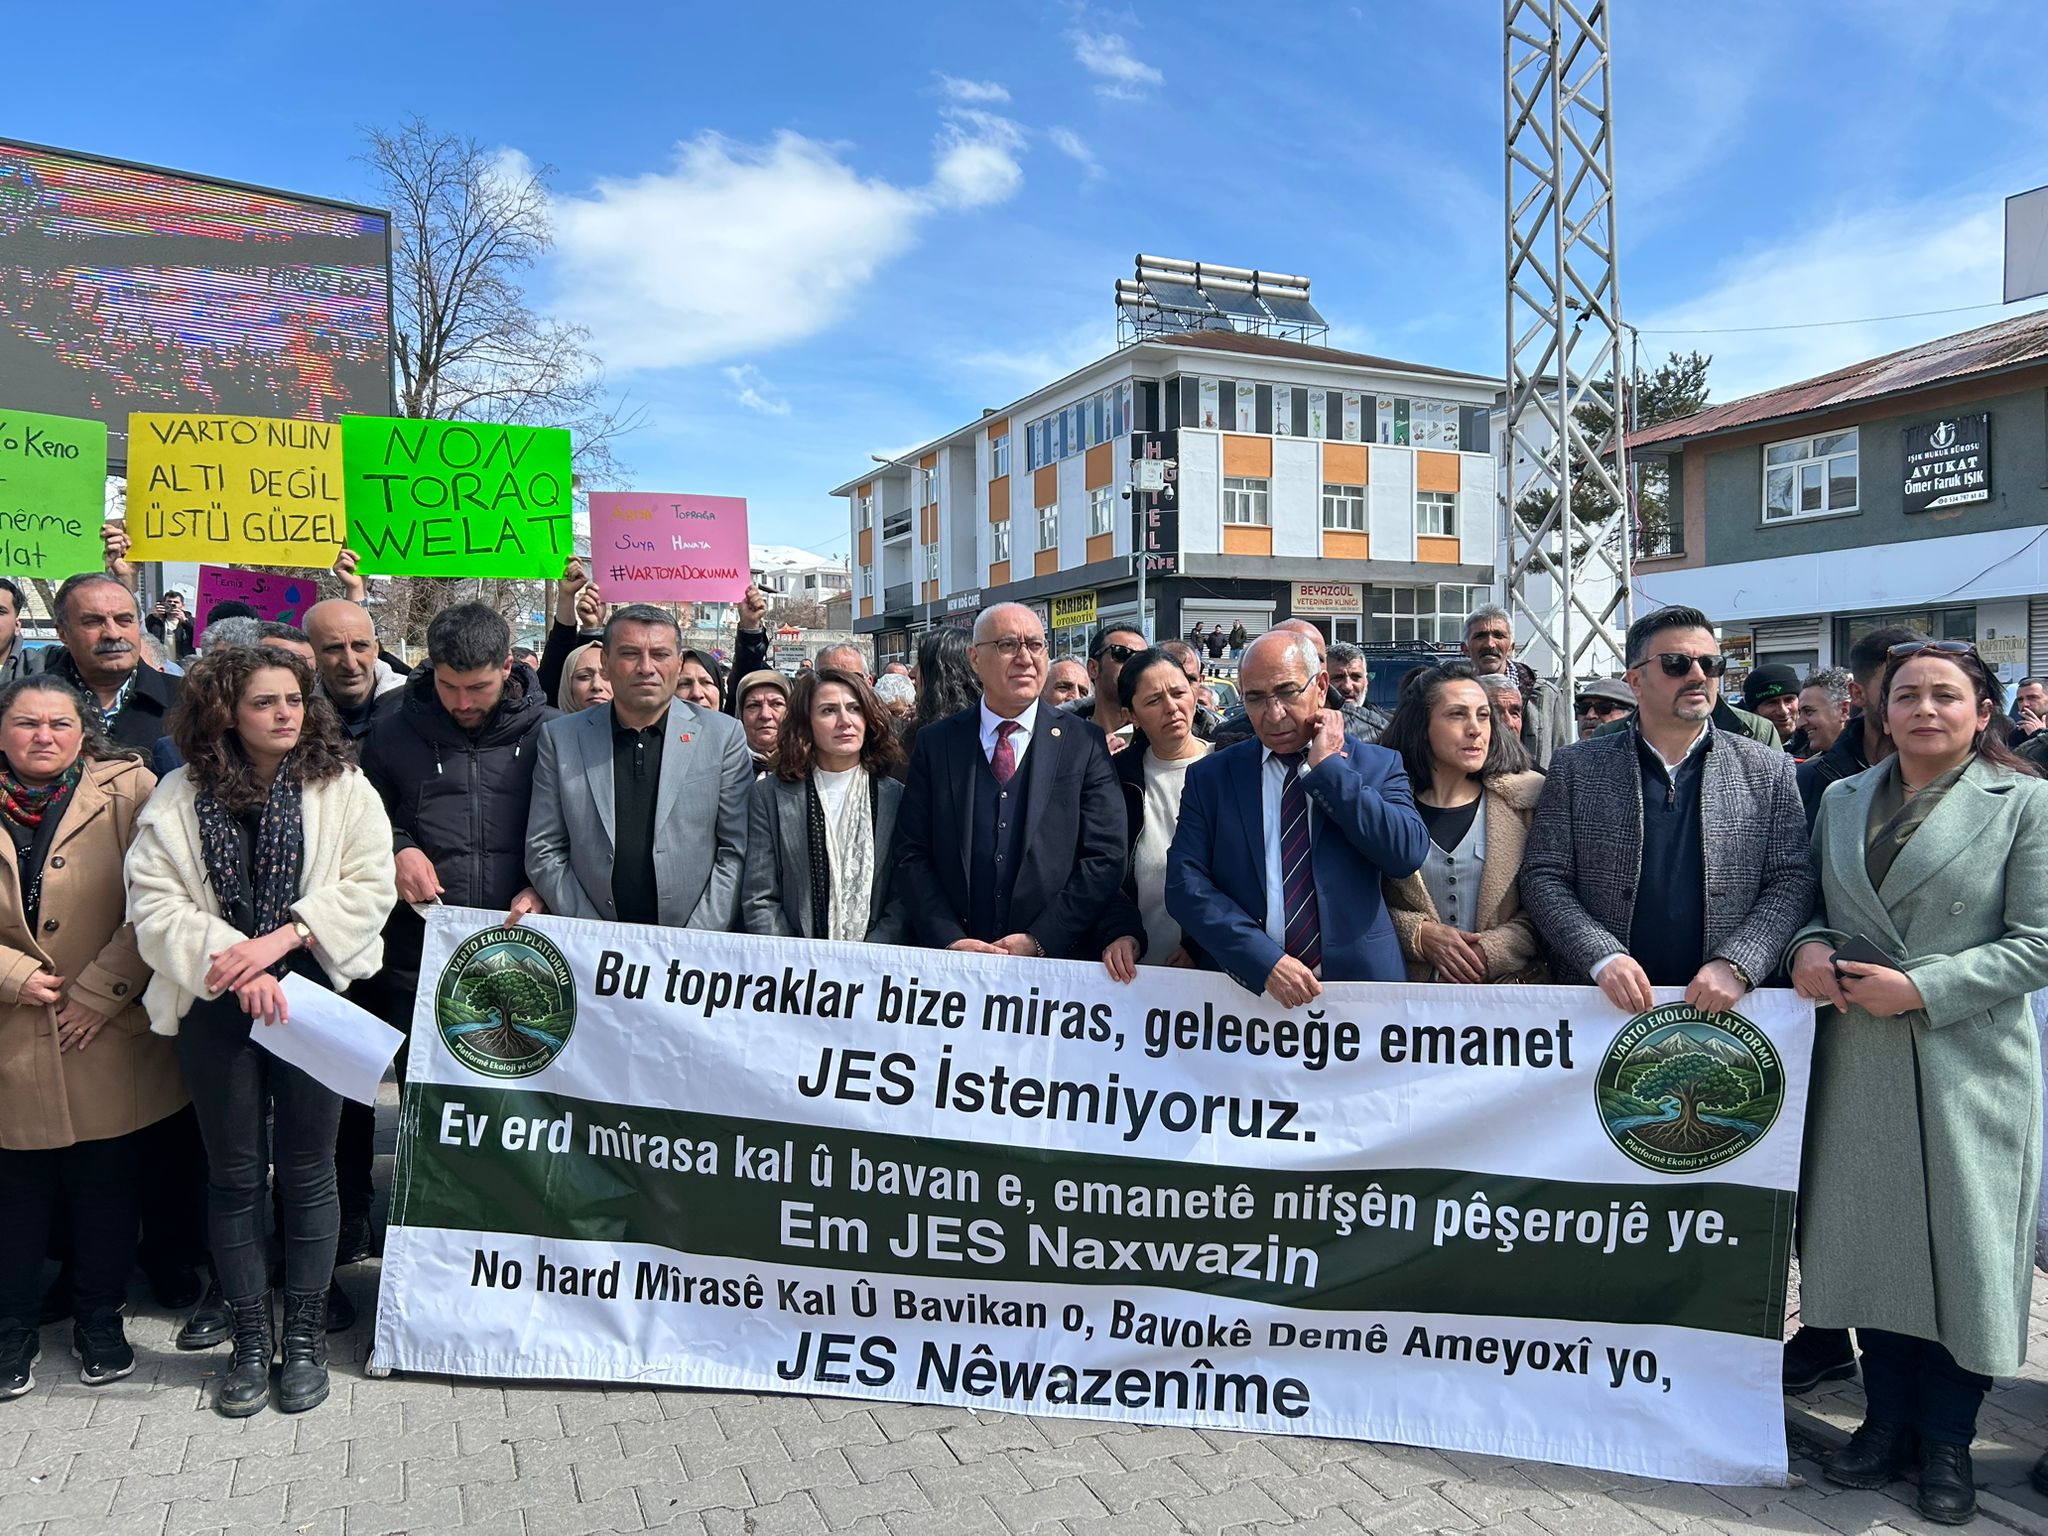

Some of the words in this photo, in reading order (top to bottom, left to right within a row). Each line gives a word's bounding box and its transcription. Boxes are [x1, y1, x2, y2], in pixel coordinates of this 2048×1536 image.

[25, 426, 79, 459] Keno
[150, 420, 331, 450] VARTO'NUN
[383, 425, 536, 470] NON
[149, 463, 225, 492] ALTI
[250, 465, 340, 501] DEĞİL
[1905, 479, 1931, 495] Ömer
[1934, 474, 1961, 490] Faruk
[1964, 470, 1984, 487] IŞIK
[1911, 456, 1978, 479] AVUKAT
[362, 472, 560, 513] TORAQ
[146, 502, 230, 542] ÜSTÜ
[243, 506, 346, 545] GÜZEL
[353, 514, 572, 561] WELAT
[0, 539, 47, 568] lat
[1056, 594, 1094, 616] SARIBEY
[1301, 585, 1353, 597] BEYAZGÜL
[1056, 611, 1094, 627] OTOMOTİV
[450, 940, 478, 973] VARTO
[480, 929, 524, 946] EKOLOJİ
[525, 933, 570, 987] PLATFORMU
[595, 951, 650, 999] Bu
[665, 960, 864, 1019] topraklar
[877, 975, 967, 1028] bize
[982, 987, 1124, 1052] miras,
[1144, 1002, 1361, 1070] geleceğe
[1380, 1019, 1574, 1070] emanet
[1611, 1022, 1647, 1062] VARTO
[1706, 1011, 1775, 1069] PLATFORMU
[798, 1048, 916, 1105] JES
[936, 1045, 1317, 1143] İstemiyoruz.
[440, 1102, 489, 1147] Ev
[501, 1112, 573, 1154] erd
[588, 1122, 718, 1175] mîrasa
[735, 1136, 794, 1184] kal
[811, 1144, 832, 1188] û
[851, 1148, 980, 1203] bavan
[998, 1175, 1035, 1214] e,
[1054, 1180, 1255, 1219] emanetê
[1273, 1182, 1416, 1236] nifşên
[1434, 1192, 1649, 1254] pêşerojê
[1668, 1209, 1739, 1253] ye.
[780, 1200, 868, 1254] Em
[889, 1214, 1006, 1264] JES
[1029, 1224, 1319, 1289] Naxwazin
[471, 1250, 522, 1290] No
[537, 1255, 619, 1300] hard
[634, 1262, 764, 1310] Mîrasê
[778, 1279, 836, 1316] Kal
[851, 1279, 877, 1318] Û
[894, 1289, 1047, 1329] Bavikan
[1063, 1304, 1094, 1342] o,
[1109, 1300, 1252, 1348] Bavokê
[1268, 1323, 1388, 1353] Demê
[1403, 1326, 1593, 1376] Ameyoxî
[1606, 1347, 1671, 1393] yo,
[776, 1331, 897, 1387] JES
[916, 1337, 1310, 1419] Nêwazenîme
